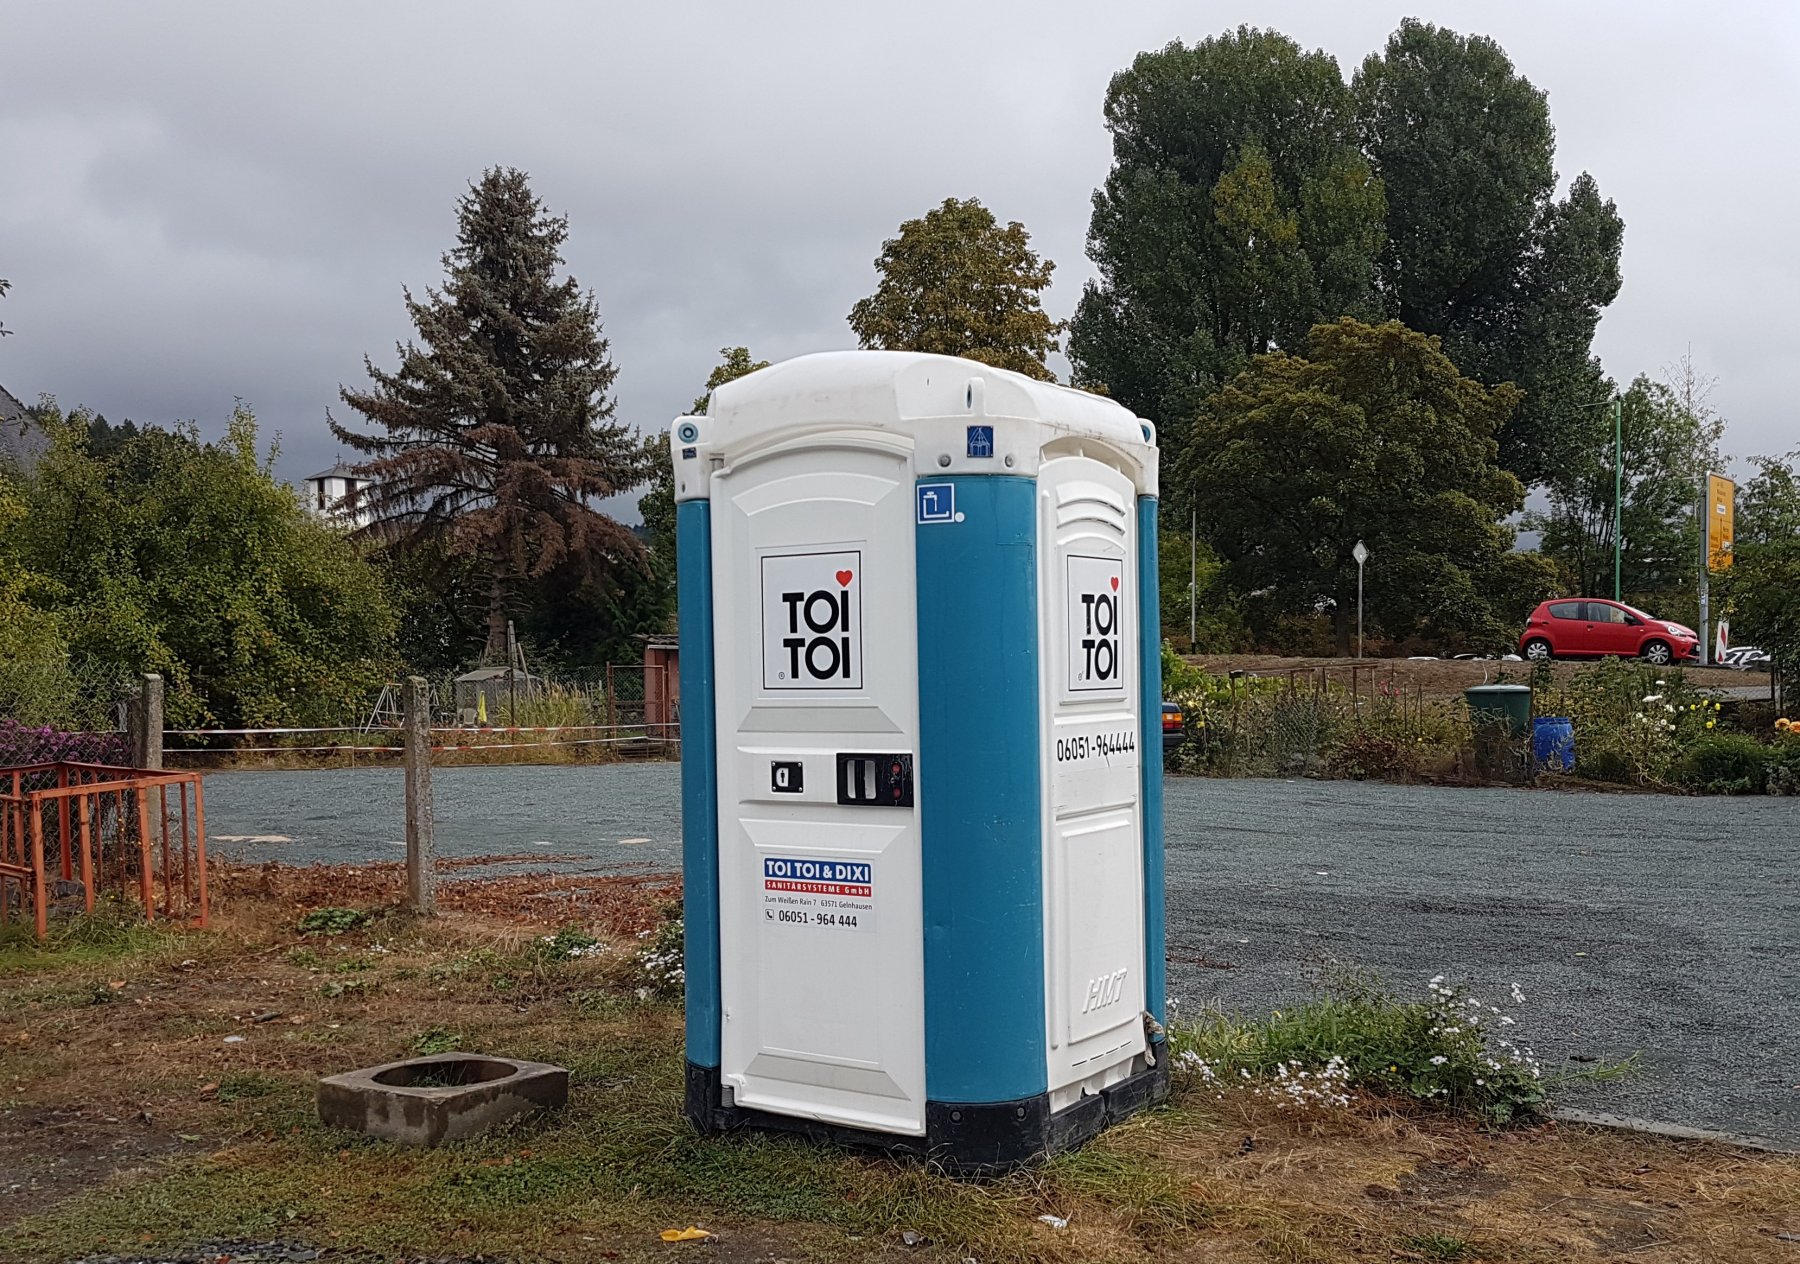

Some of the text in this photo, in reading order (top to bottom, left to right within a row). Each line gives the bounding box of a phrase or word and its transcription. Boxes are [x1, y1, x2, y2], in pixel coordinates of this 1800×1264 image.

[782, 590, 849, 634] TOI
[1081, 593, 1118, 636] TOI
[783, 636, 850, 680] TOI
[1081, 638, 1118, 681] TOI
[1057, 731, 1135, 762] 06051-964444
[766, 860, 869, 882] TOI TOI & DIXI
[800, 898, 812, 906] Rain
[821, 900, 838, 908] 63571
[838, 902, 873, 911] Gelnhausen
[844, 886, 870, 895] GmbH
[838, 915, 858, 928] 444
